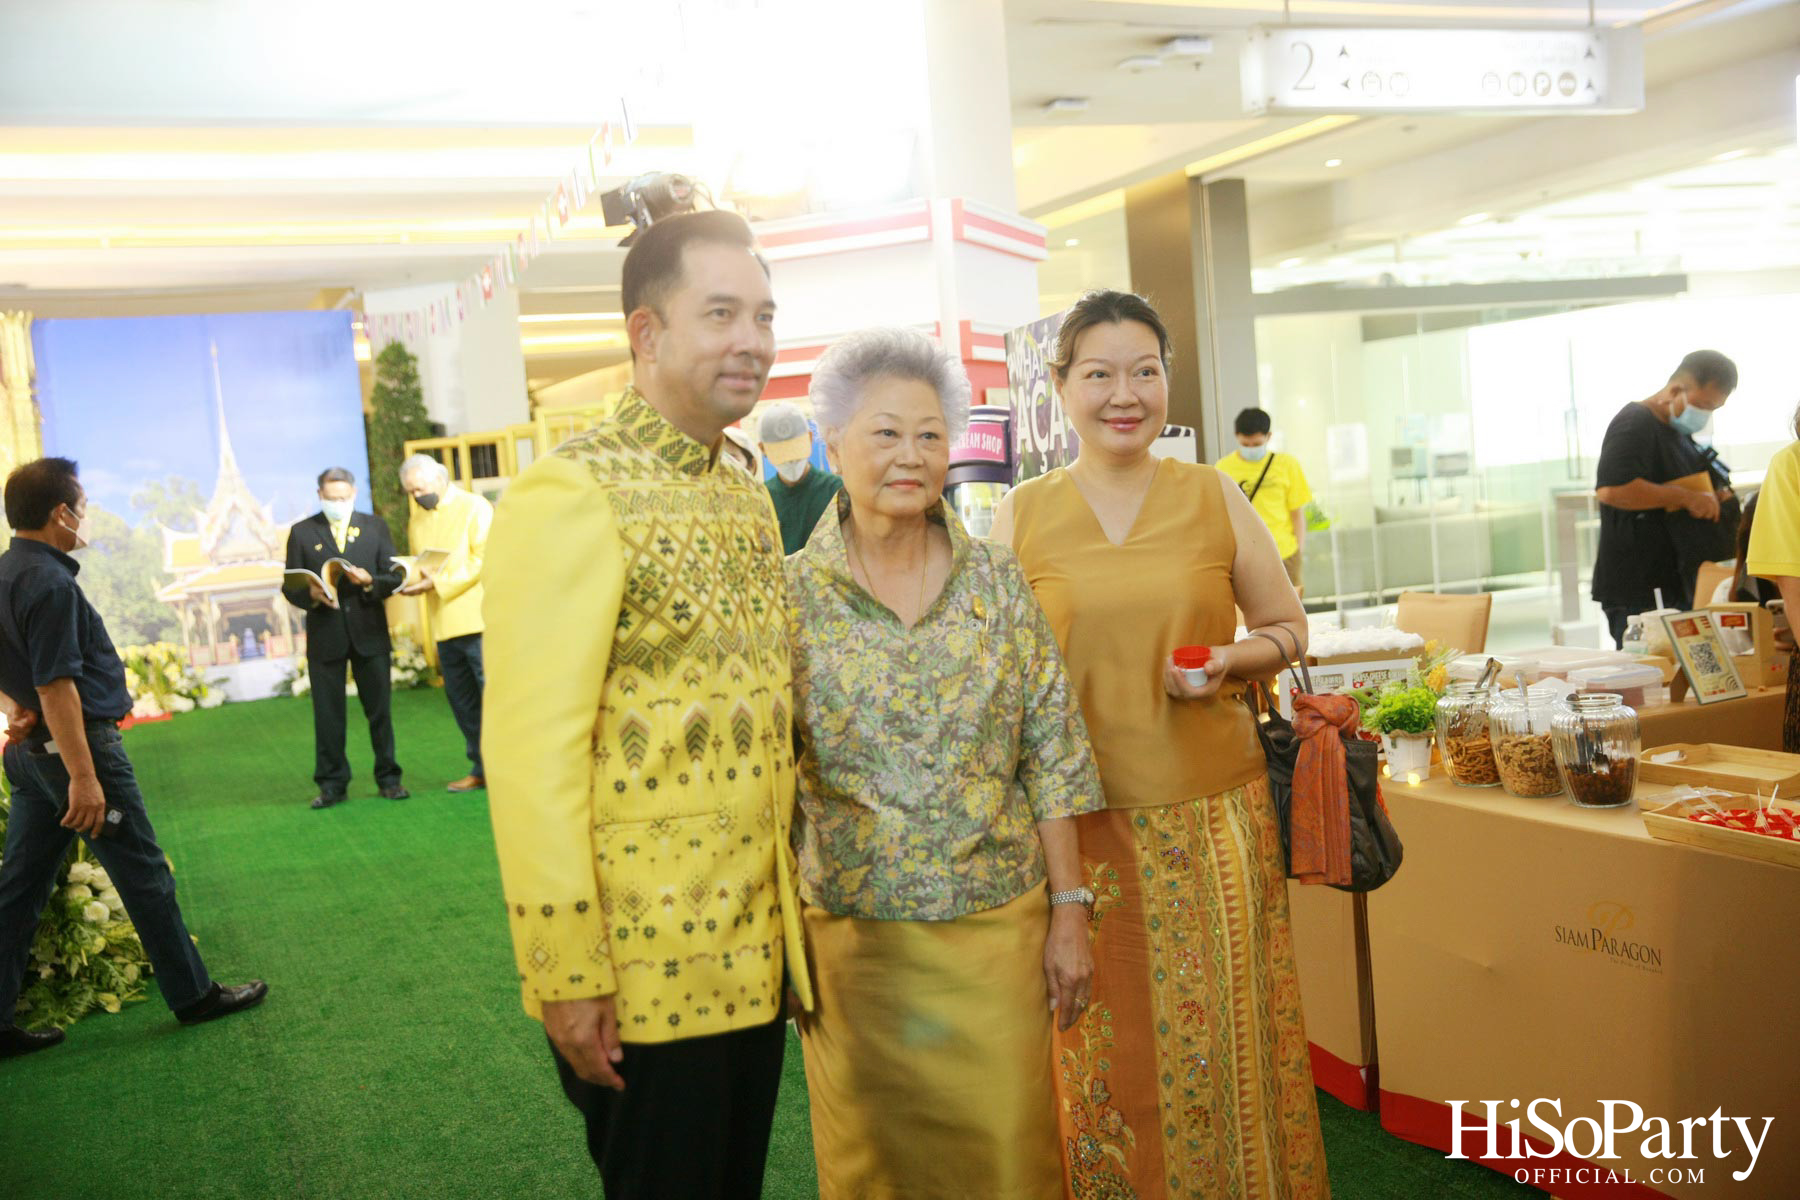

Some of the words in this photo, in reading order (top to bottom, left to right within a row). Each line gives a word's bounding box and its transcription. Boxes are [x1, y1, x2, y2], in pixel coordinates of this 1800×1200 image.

[1290, 41, 1316, 92] 2
[981, 432, 1002, 455] SHOP
[1016, 379, 1073, 474] AÇA
